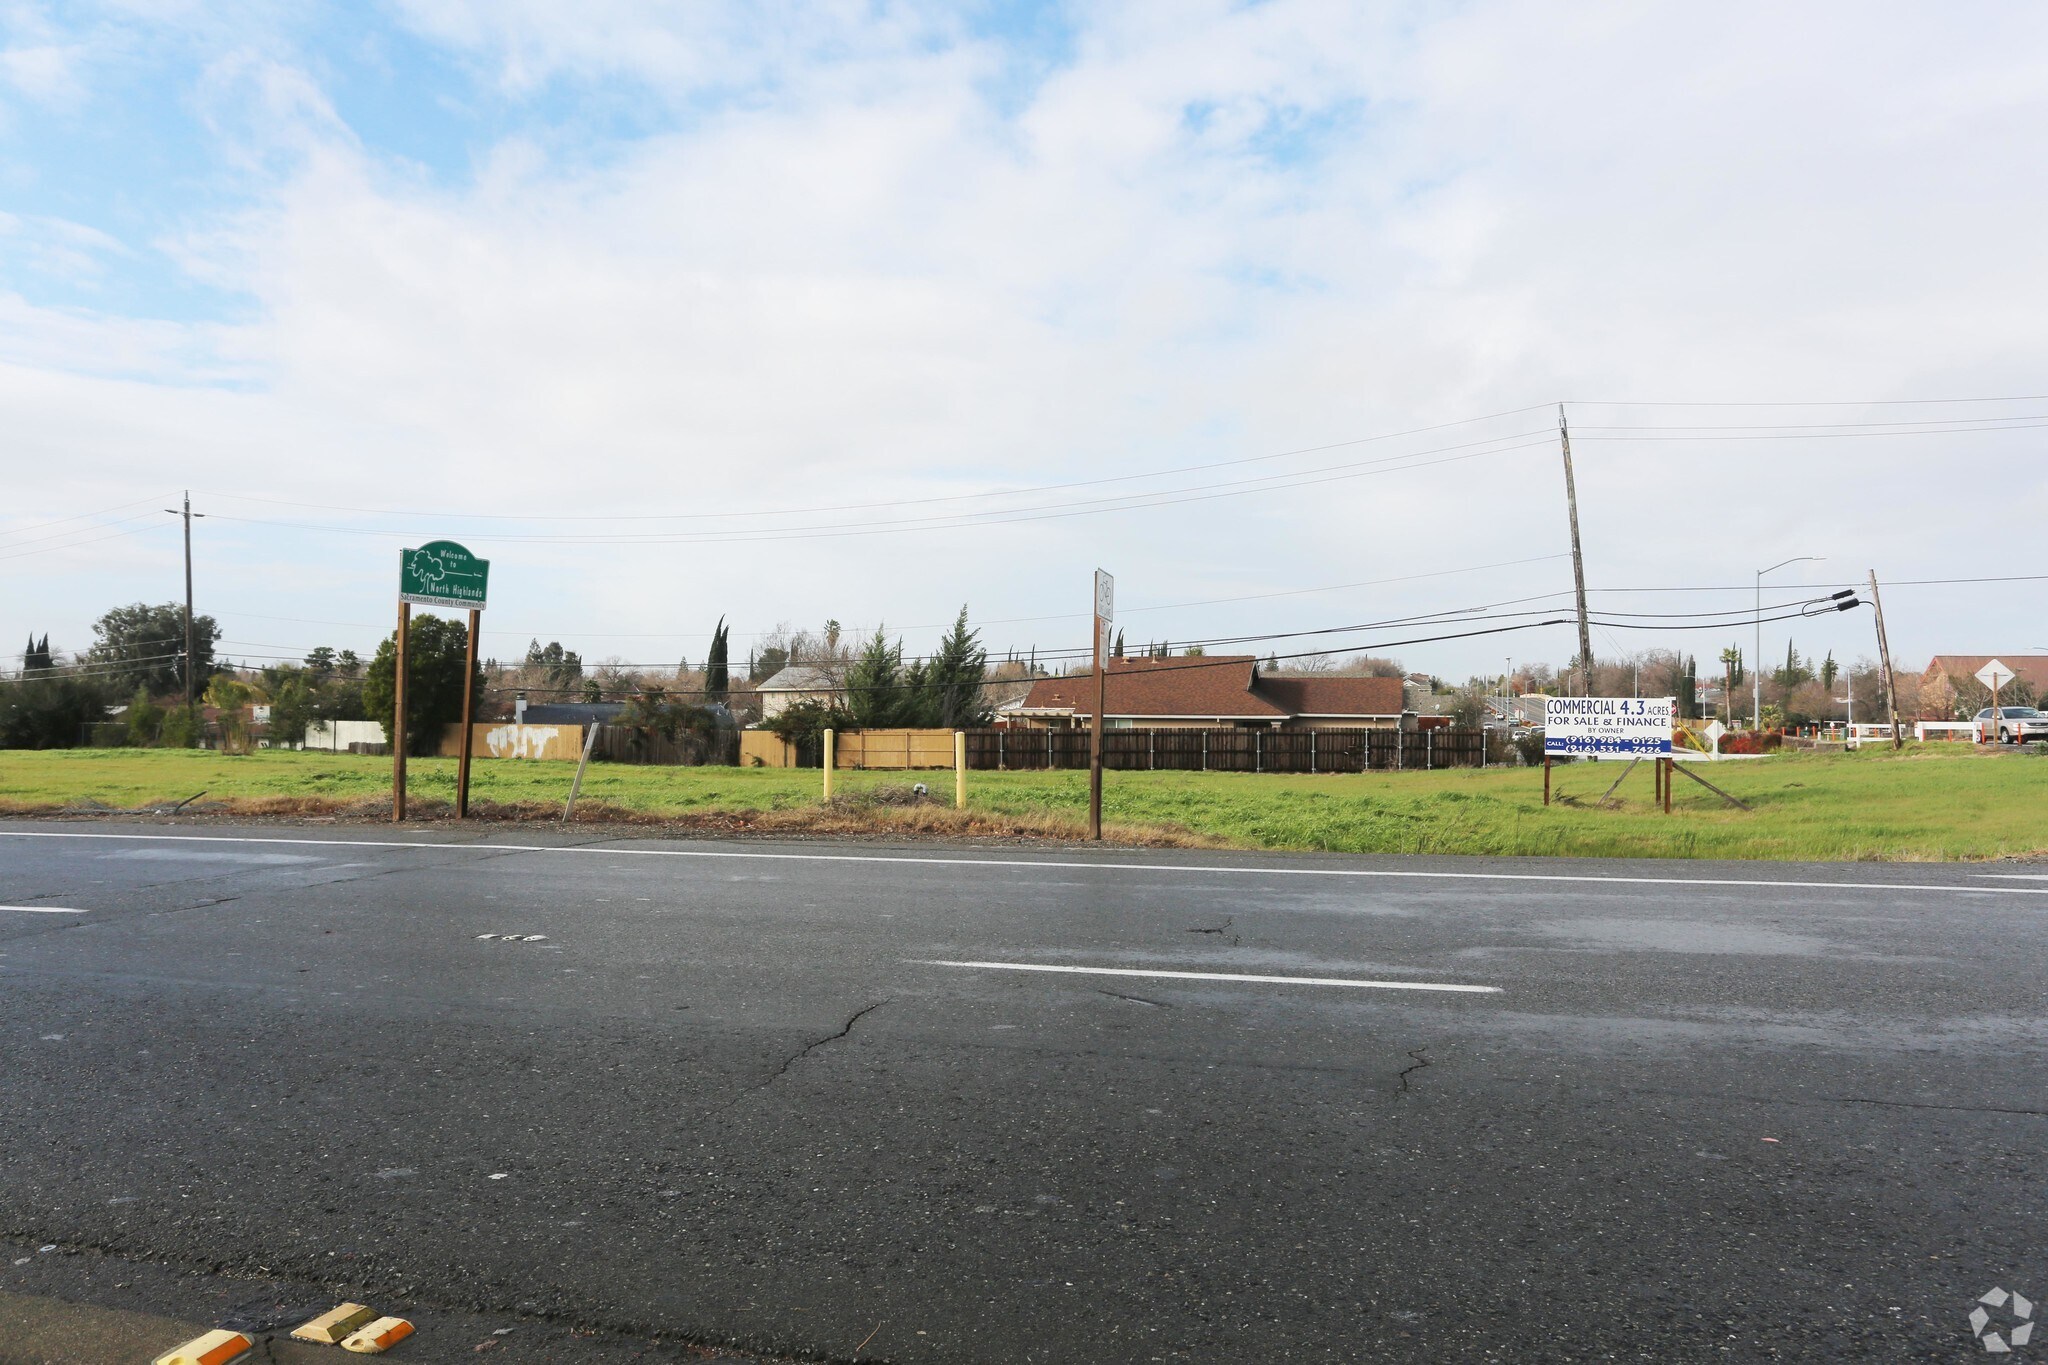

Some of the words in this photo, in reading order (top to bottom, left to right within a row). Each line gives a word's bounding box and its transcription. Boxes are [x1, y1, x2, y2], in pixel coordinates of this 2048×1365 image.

[440, 549, 467, 561] Welcome
[430, 582, 450, 594] North
[452, 584, 482, 598] Highlands
[400, 594, 432, 604] Sacramento
[434, 596, 454, 607] County
[455, 598, 486, 610] Community
[1546, 699, 1616, 715] COMMERCIAL
[1620, 700, 1645, 716] 4.3
[1548, 716, 1570, 726] FOR
[1574, 716, 1599, 726] SALE
[1603, 718, 1612, 726] &
[1616, 718, 1666, 727] FINANCE
[1565, 736, 1596, 745] (916)
[1632, 736, 1662, 745] 0125
[1565, 744, 1596, 754] (916)
[1600, 745, 1621, 753] 531
[1632, 746, 1662, 754] 7426
